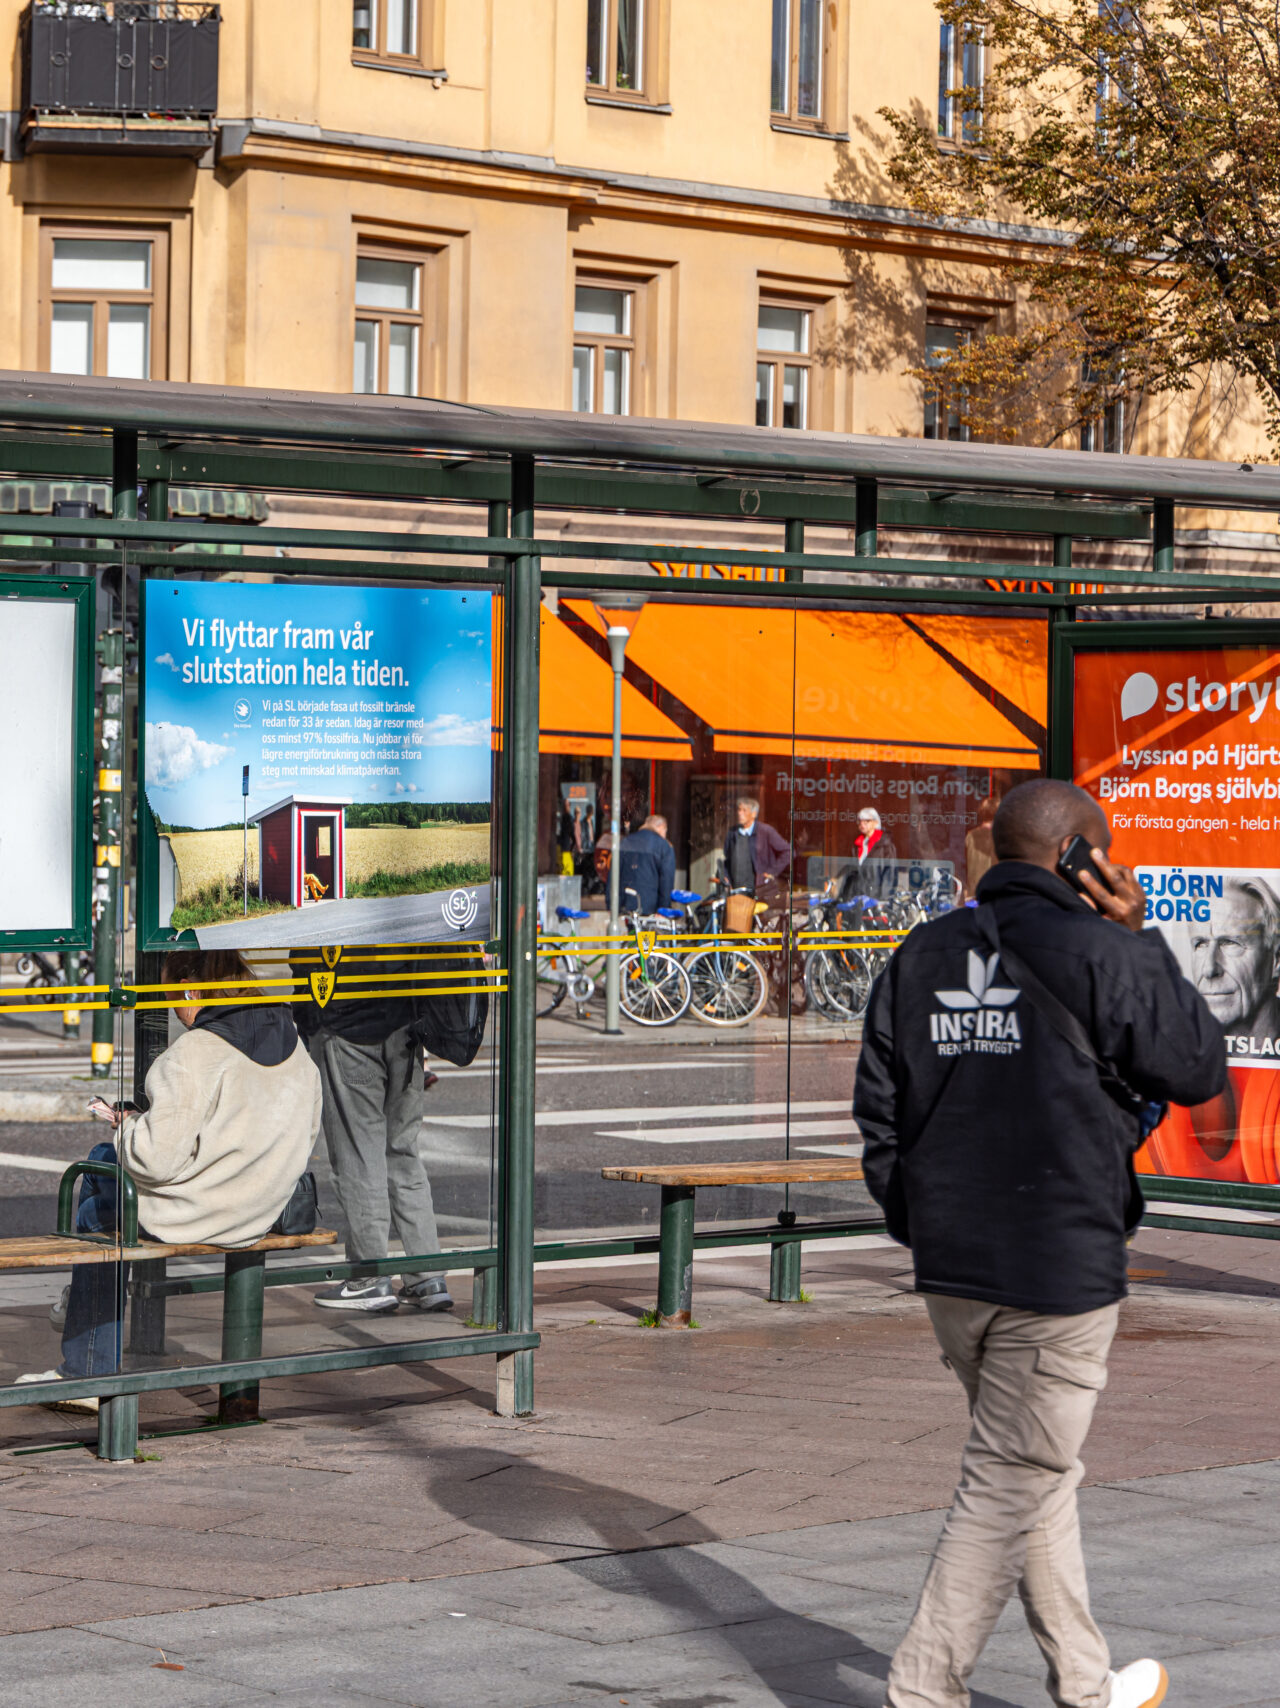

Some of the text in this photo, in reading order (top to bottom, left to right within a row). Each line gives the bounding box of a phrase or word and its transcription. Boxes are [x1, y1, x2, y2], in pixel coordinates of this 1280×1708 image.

[182, 618, 374, 654] Vi flyttar fram vår
[182, 655, 409, 687] slutstation hela tiden.
[262, 700, 415, 714] Vi på SL började fasa ut fossilt bränsle
[262, 717, 286, 727] redan
[288, 716, 300, 727] för
[302, 717, 313, 727] 33
[315, 716, 324, 728] år
[325, 717, 352, 728] sedan.
[354, 717, 372, 730] Idag
[373, 718, 382, 728] är
[383, 720, 405, 729] resor
[406, 717, 424, 729] med
[262, 735, 276, 743] oss
[278, 733, 301, 743] minst
[324, 732, 361, 744] fossilfria.
[363, 733, 374, 744] Nu
[376, 733, 401, 746] jobbar
[403, 733, 410, 744] vi
[412, 732, 423, 744] för
[262, 749, 422, 761] lägre energiförbrukning och nästa stora
[1122, 744, 1280, 771] Lyssna på Hjärt
[262, 764, 401, 777] steg mot minskad klimatpåverkan.
[1099, 777, 1150, 803] Björn
[1155, 777, 1212, 804] Borgs
[1113, 814, 1131, 828] För
[1134, 814, 1173, 829] första
[1176, 815, 1228, 832] gången
[1241, 816, 1270, 830] hela
[1138, 868, 1223, 898] BJÖRN
